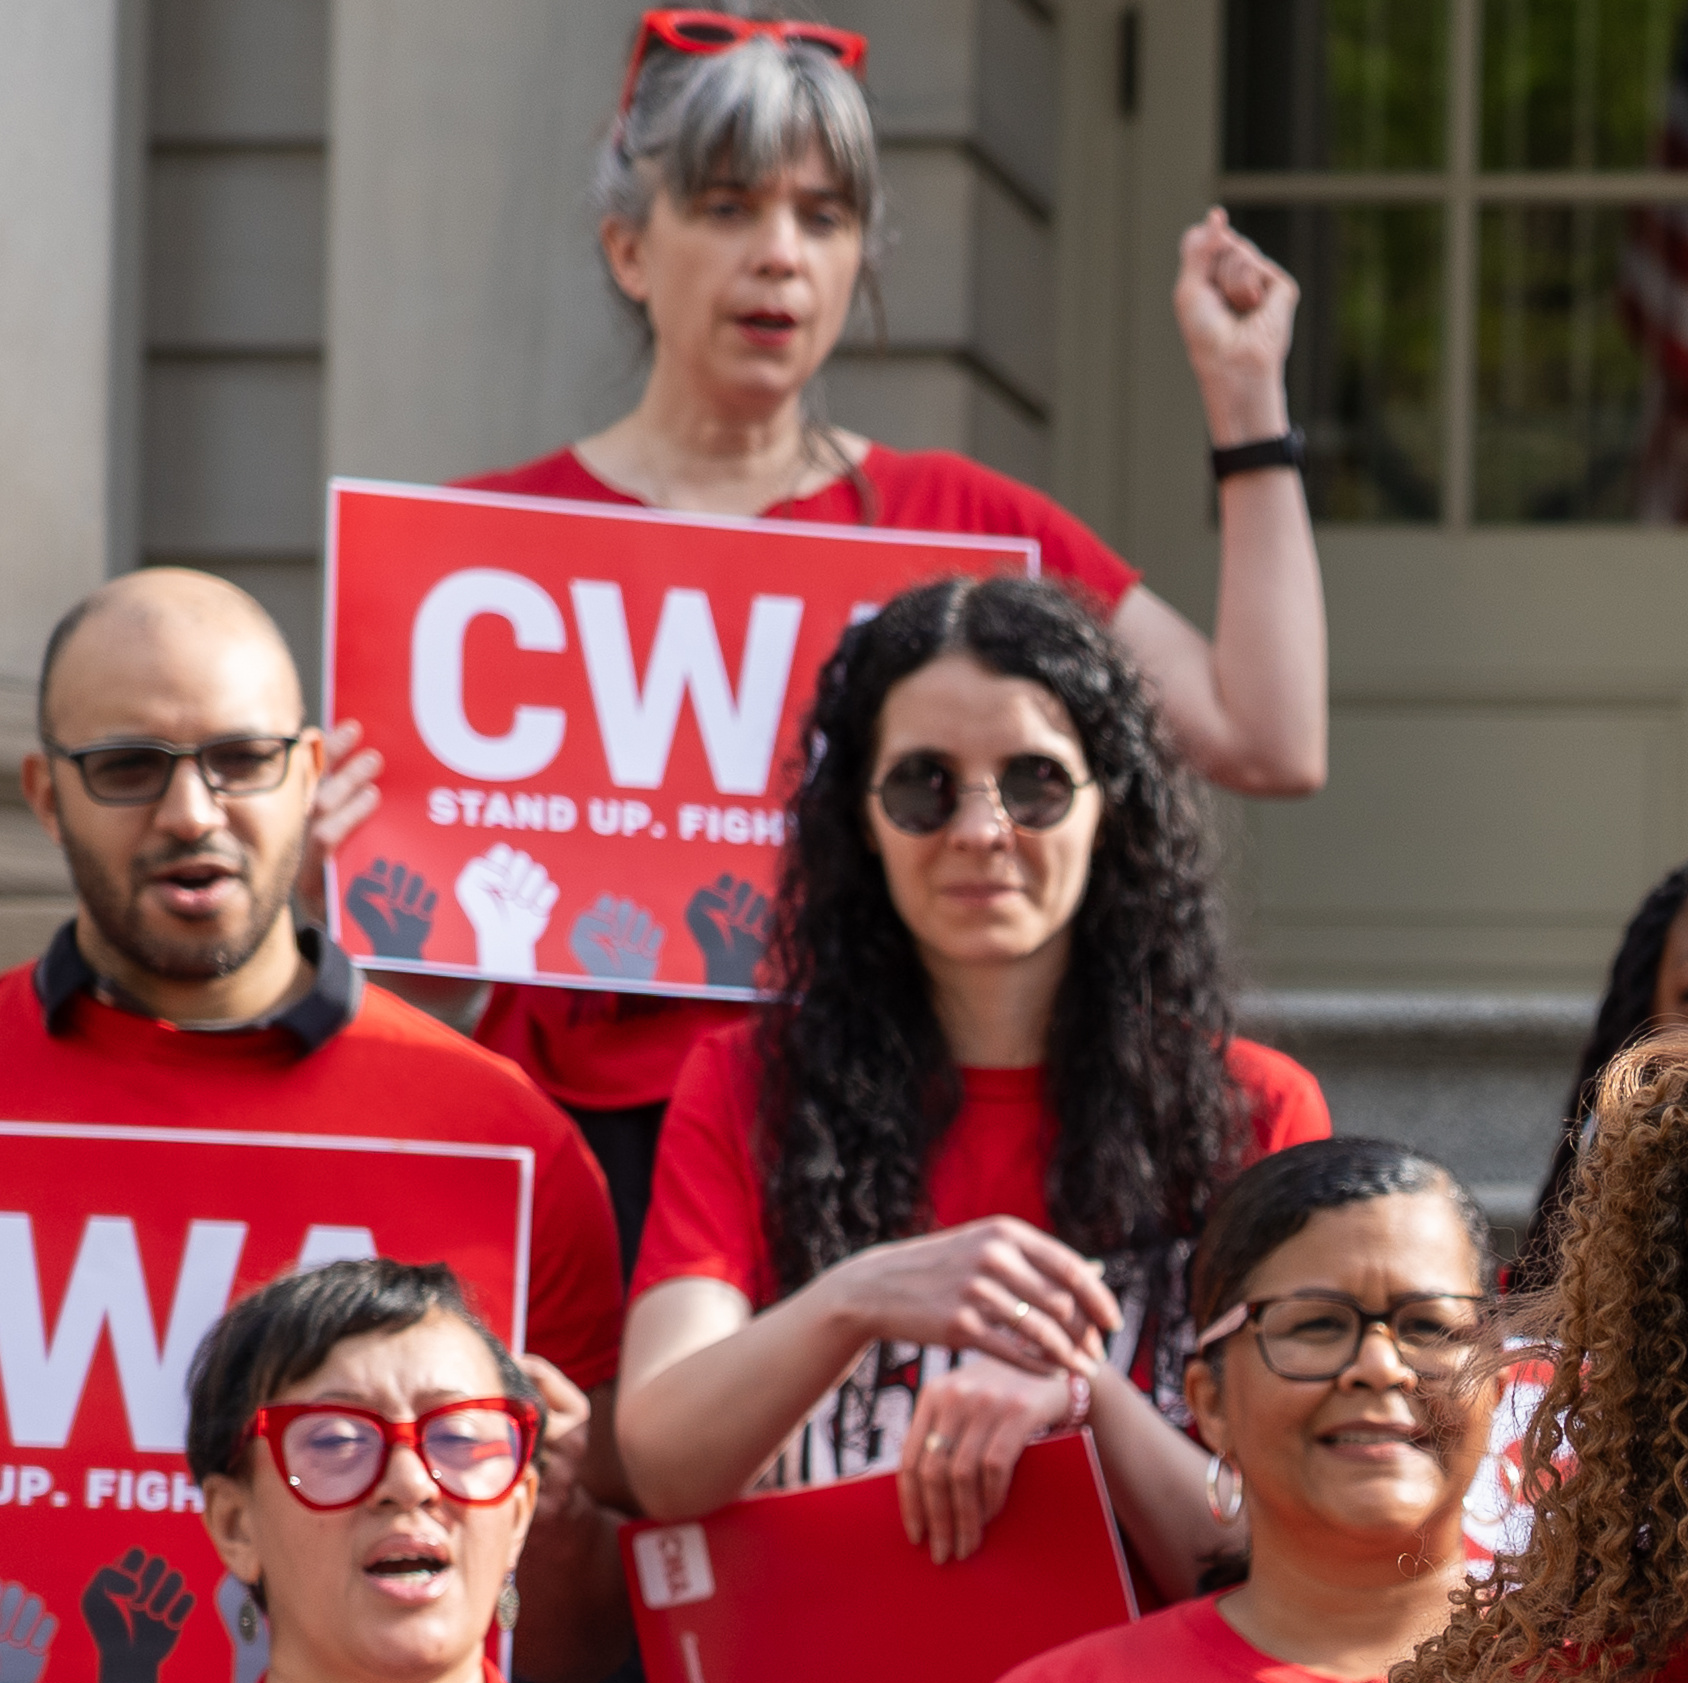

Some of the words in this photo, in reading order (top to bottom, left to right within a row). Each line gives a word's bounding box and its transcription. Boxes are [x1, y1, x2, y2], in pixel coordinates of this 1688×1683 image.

[411, 566, 881, 797] CW
[427, 786, 578, 833] STAND
[588, 797, 667, 838] UP.
[677, 802, 798, 847] FIGH
